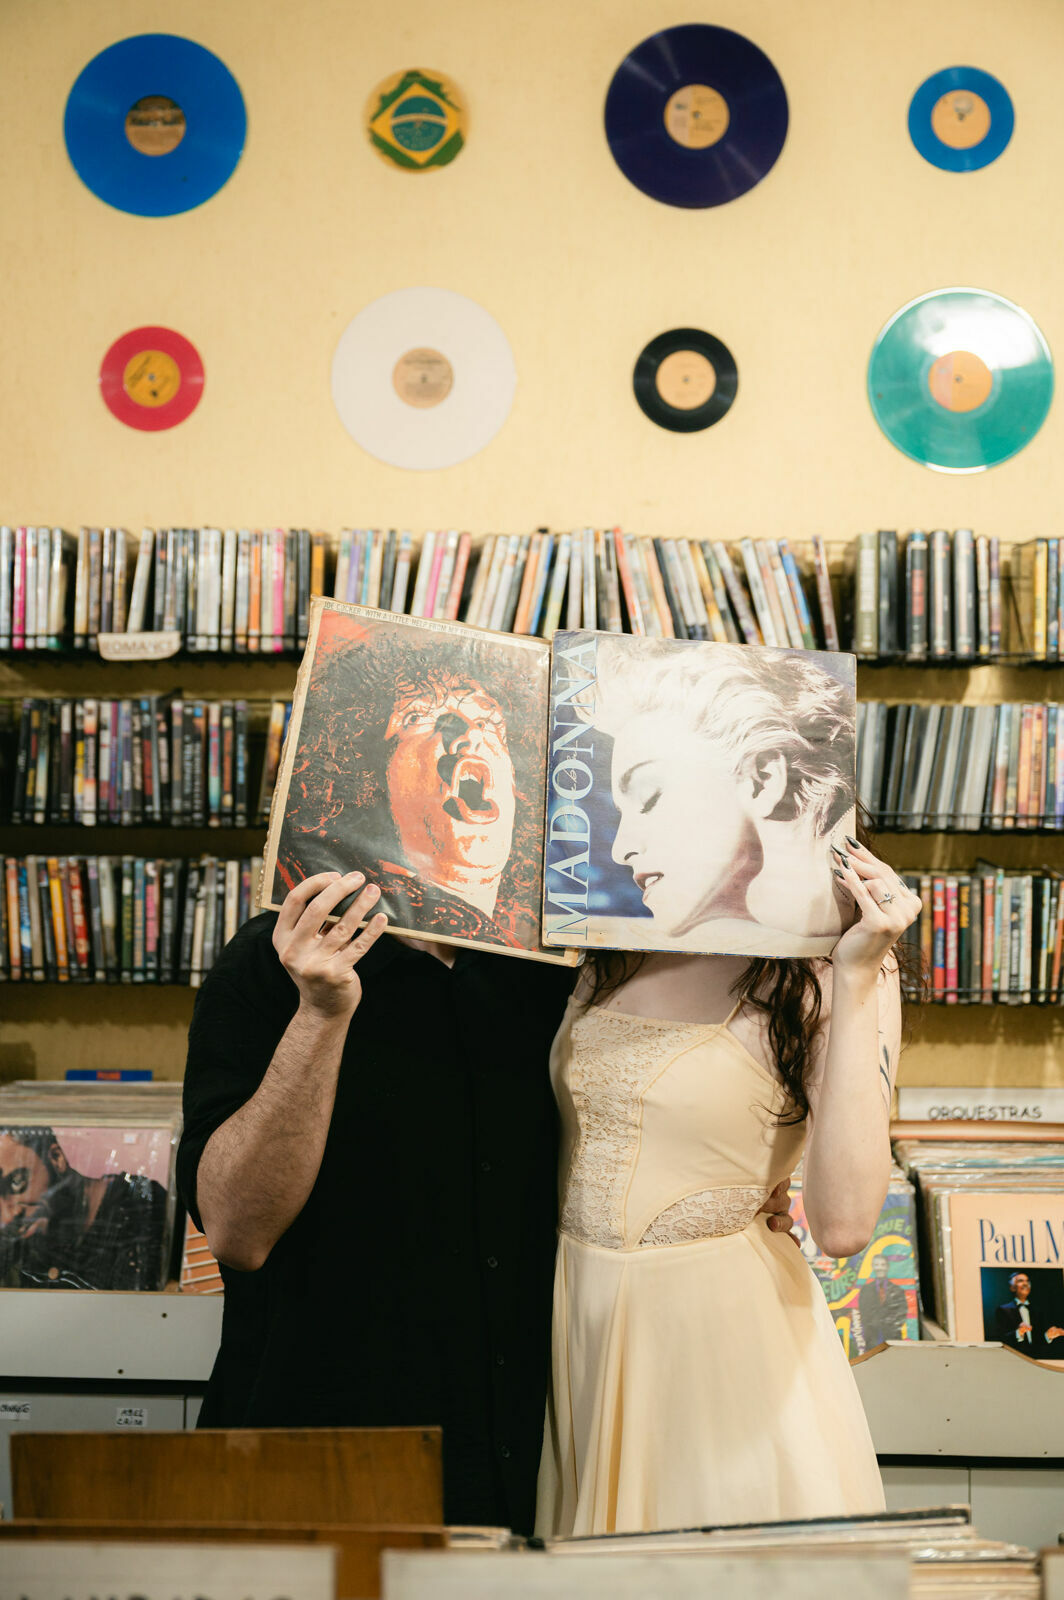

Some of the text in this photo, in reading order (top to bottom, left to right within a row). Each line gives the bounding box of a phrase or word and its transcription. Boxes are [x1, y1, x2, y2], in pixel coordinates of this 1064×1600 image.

[547, 637, 597, 941] MADONNA
[927, 1104, 1042, 1121] ORQUESTRAS
[978, 1218, 1037, 1263] Paul
